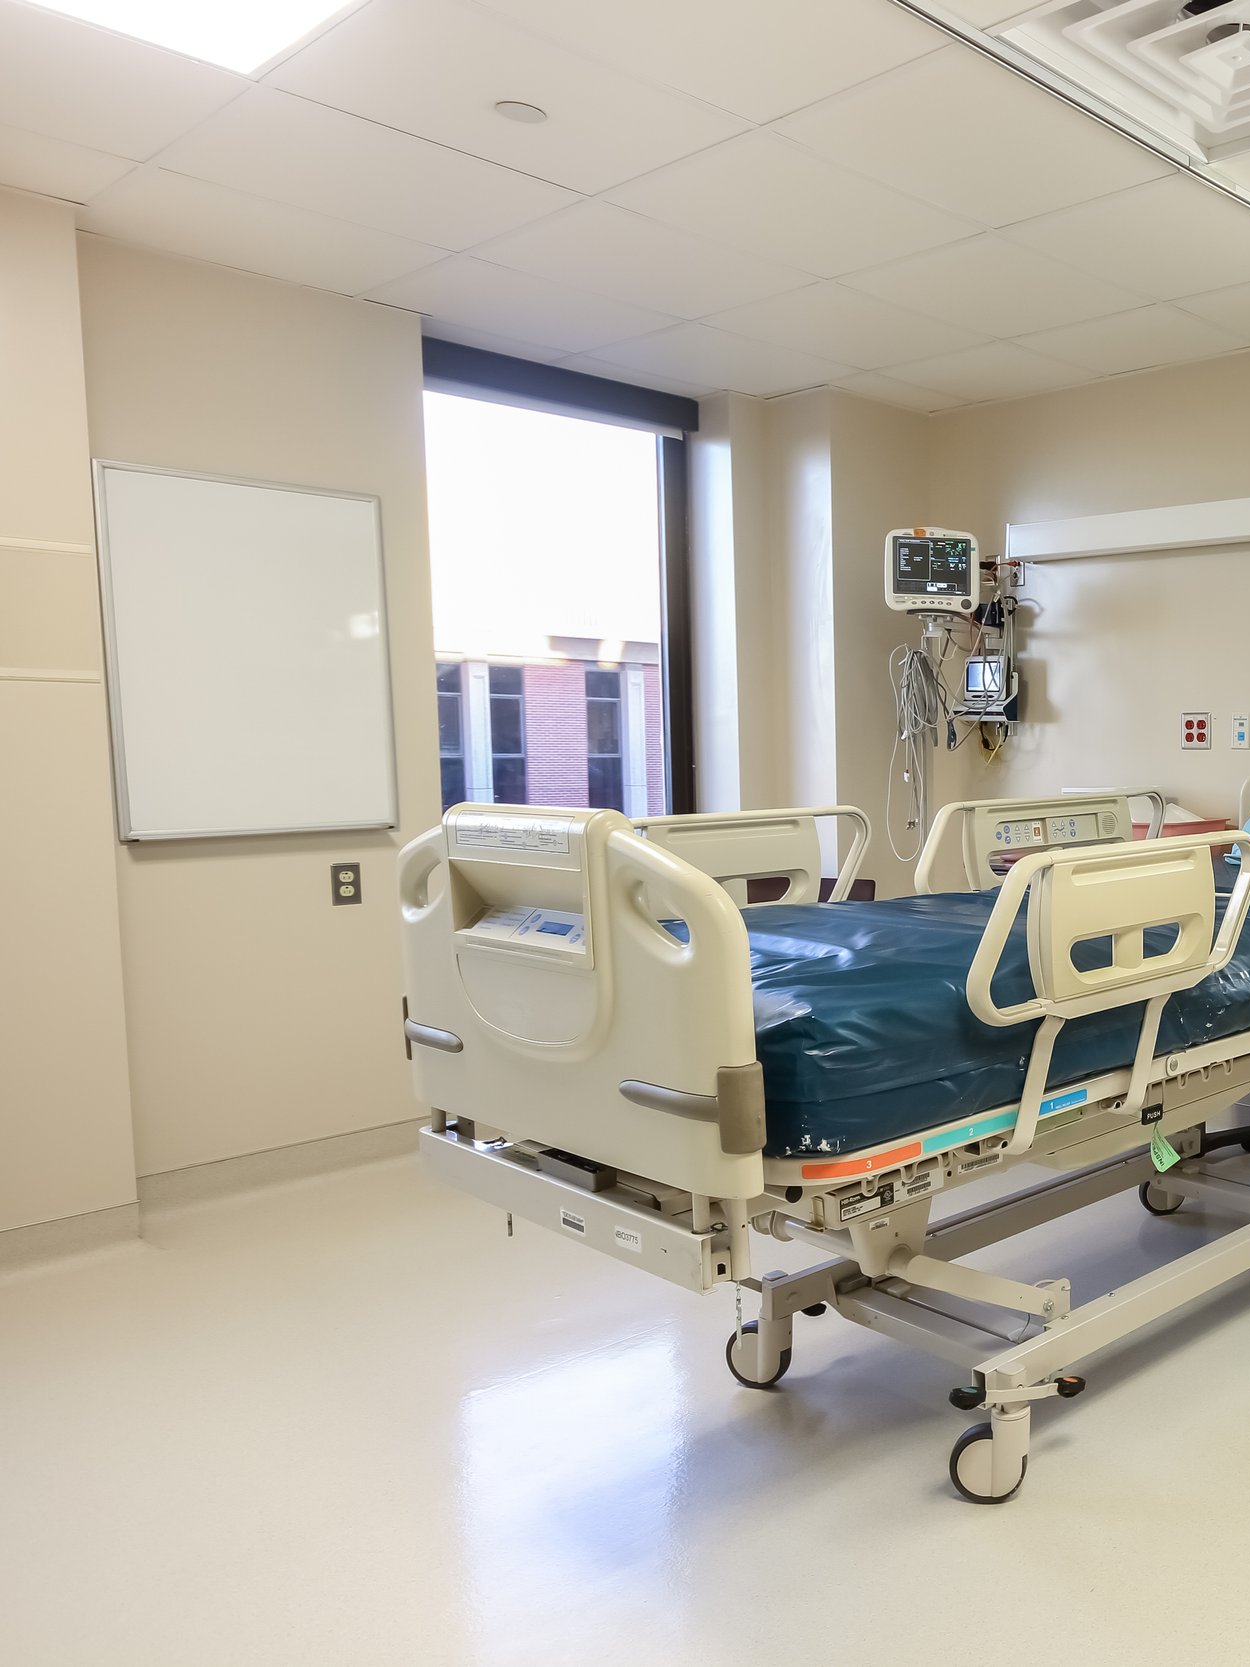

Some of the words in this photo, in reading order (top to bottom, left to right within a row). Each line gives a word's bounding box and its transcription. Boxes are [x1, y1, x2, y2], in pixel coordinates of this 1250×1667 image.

[1146, 1110, 1161, 1120] PUSH
[968, 1127, 975, 1137] 2
[866, 1160, 872, 1169] 3
